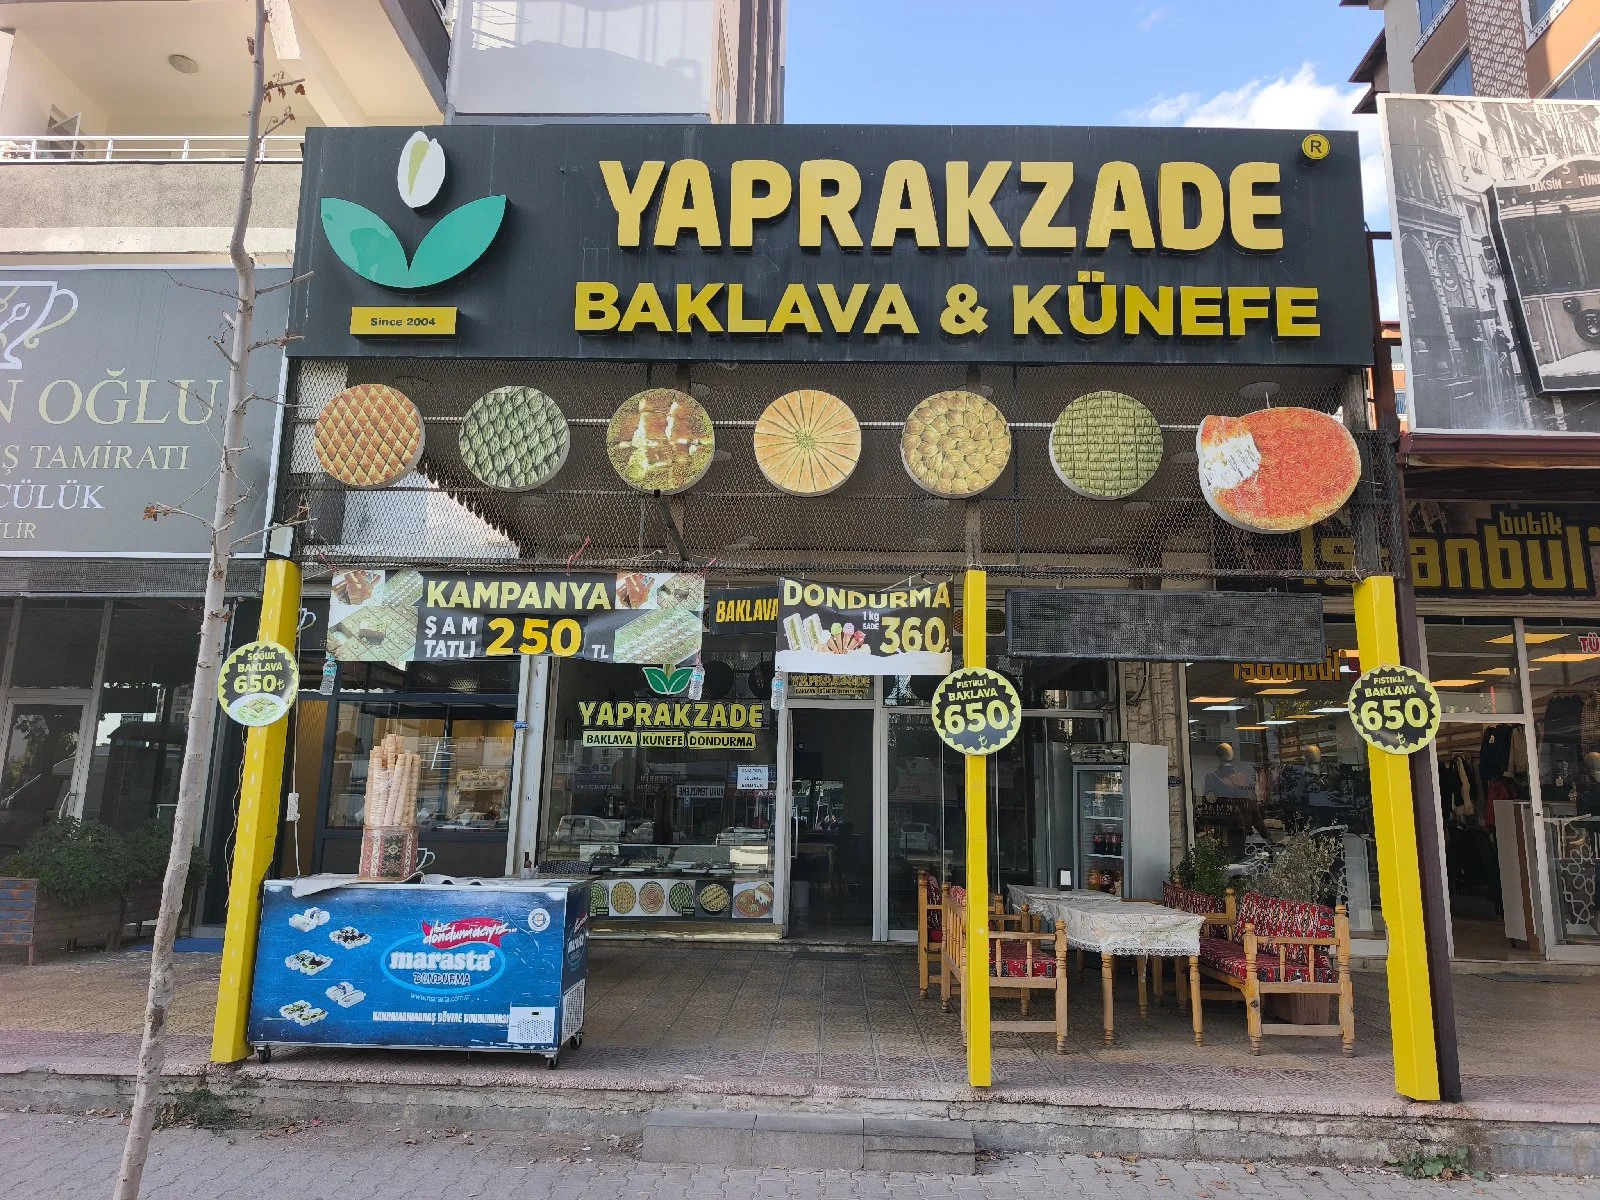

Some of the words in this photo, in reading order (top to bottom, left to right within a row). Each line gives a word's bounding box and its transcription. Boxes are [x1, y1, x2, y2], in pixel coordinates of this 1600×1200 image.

[599, 158, 1284, 251] YAPRAKZADE
[575, 281, 920, 335] BAKLAVA
[940, 284, 988, 335] &
[1013, 271, 1321, 337] KÜNEFE
[370, 317, 402, 327] Since
[406, 317, 436, 327] 2004
[38, 368, 223, 425] OĞLU
[0, 444, 20, 475] Ş
[30, 440, 191, 470] TAMİRATI
[0, 479, 105, 509] CÜLÜK
[0, 520, 37, 539] LİR
[1499, 511, 1564, 535] butik
[427, 581, 612, 611] KAMPANYA
[783, 579, 951, 610] DONDURMA
[716, 598, 778, 623] BAKLAVA
[863, 611, 868, 620] 1
[869, 611, 880, 622] kg
[486, 618, 582, 656] 250
[863, 622, 880, 630] SADE
[880, 616, 946, 654] 360
[592, 645, 609, 659] TL
[1578, 632, 1600, 653] TÜ
[248, 651, 276, 660] SOĞUK
[238, 662, 283, 673] BAKLAVA
[957, 679, 987, 688] FISTIKLI
[1365, 685, 1416, 697] BAKLAVA
[1374, 676, 1405, 684] FISTIKLI
[948, 688, 998, 701] BAKLAVA
[578, 702, 764, 728] YAPRAKZADE
[945, 700, 1009, 734] 650
[1361, 697, 1428, 730] 650
[586, 734, 633, 745] BAKLAVA
[642, 733, 683, 746] KÜNEFE
[689, 736, 753, 747] DONDURMA
[413, 972, 471, 986] DONDURMA
